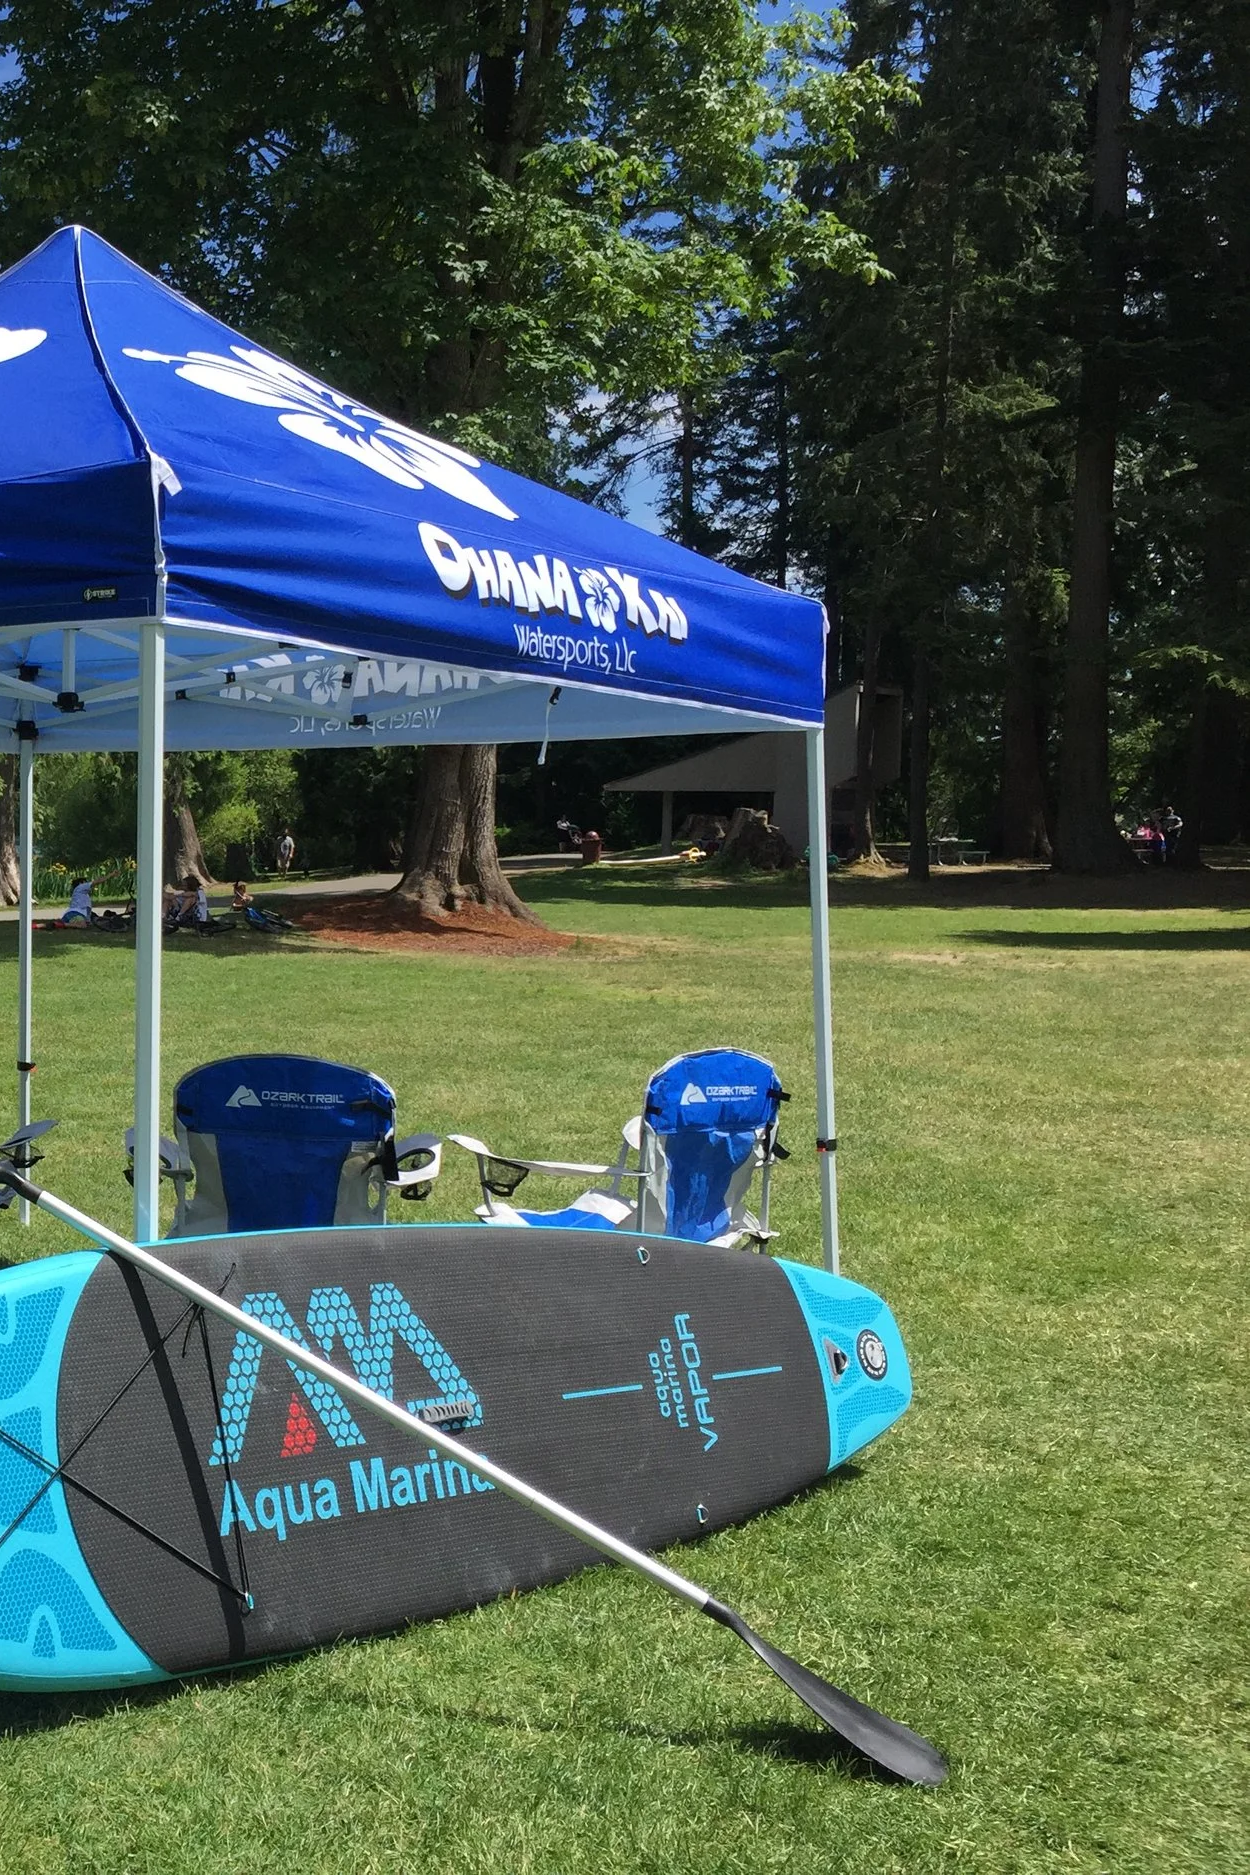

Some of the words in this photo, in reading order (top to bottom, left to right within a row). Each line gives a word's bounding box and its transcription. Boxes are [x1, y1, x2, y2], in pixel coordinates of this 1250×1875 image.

[418, 521, 583, 619] OHANA
[514, 623, 612, 674] Watersports,
[648, 1353, 672, 1417] aqua
[660, 1338, 689, 1428] marina
[674, 1313, 718, 1451] VAPOR
[220, 1479, 341, 1541] Aqua
